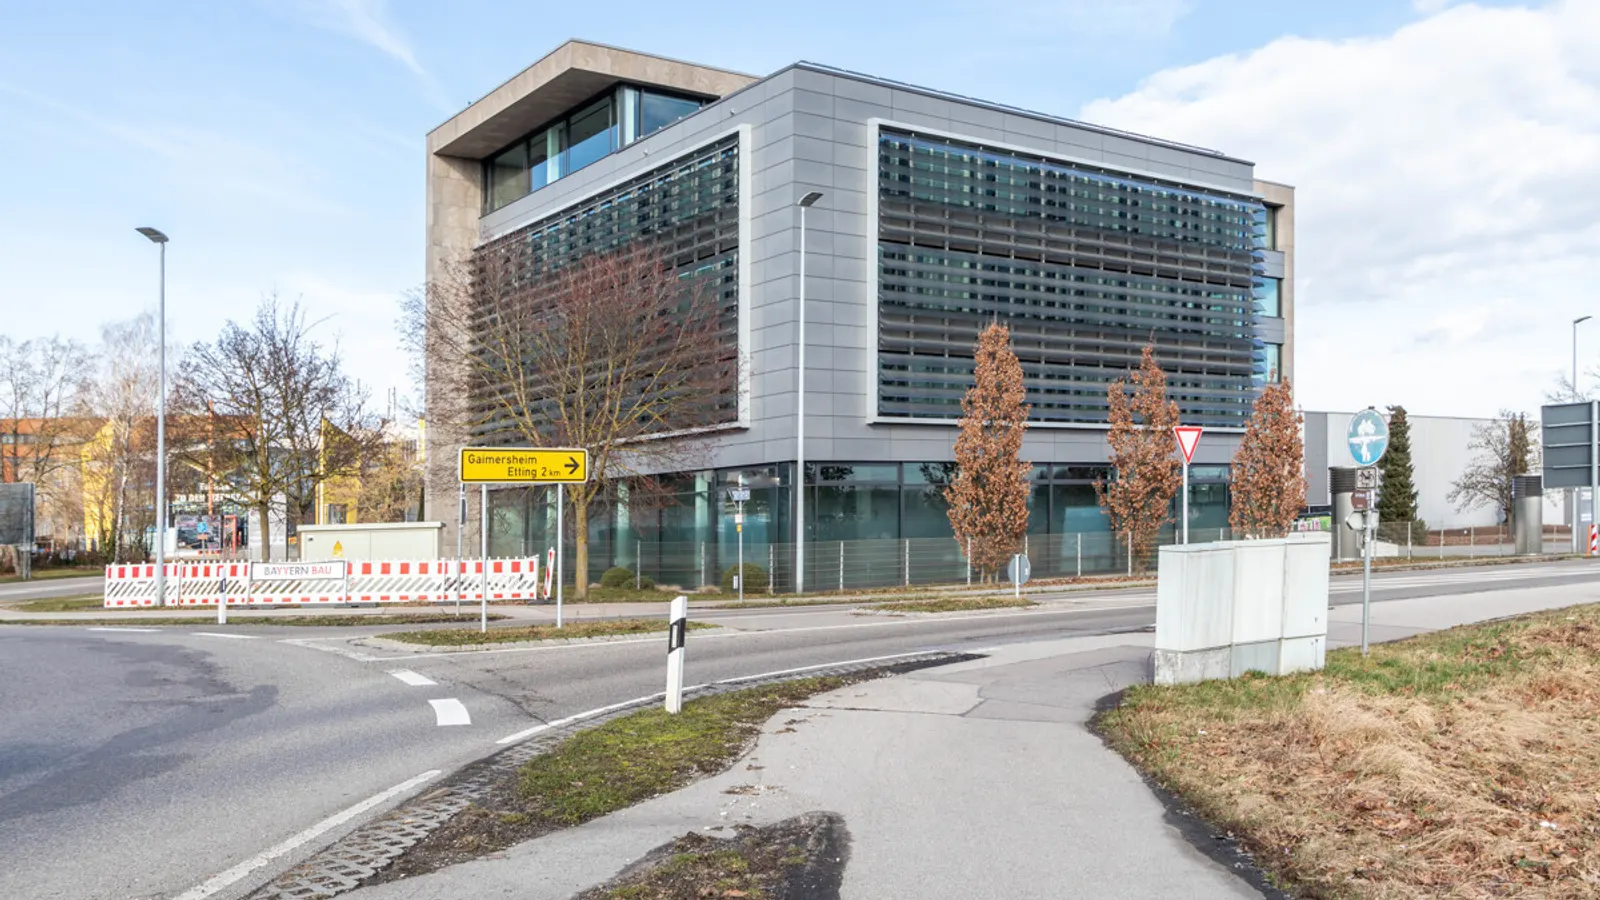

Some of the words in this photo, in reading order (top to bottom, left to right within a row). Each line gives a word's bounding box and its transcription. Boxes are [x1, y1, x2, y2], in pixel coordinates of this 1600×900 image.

[468, 453, 537, 464] Gaimersheim
[507, 466, 537, 478] Etting
[541, 467, 547, 476] 2
[263, 566, 309, 576] BAYYERN
[311, 565, 332, 575] BAU
